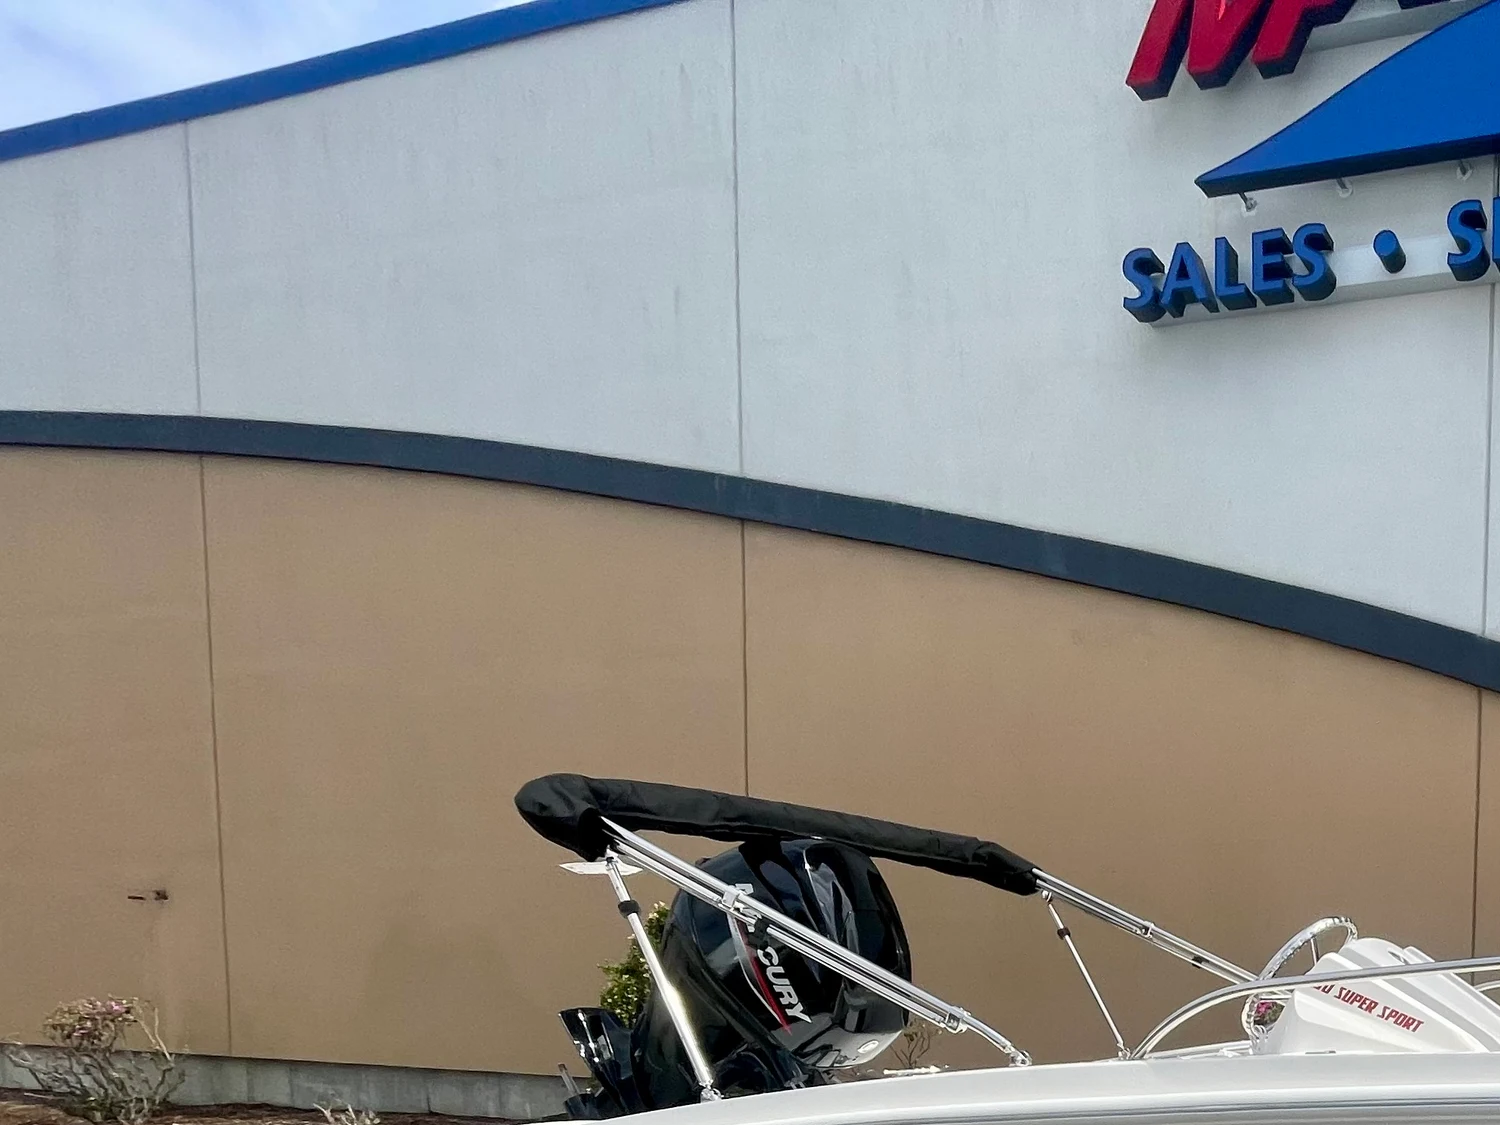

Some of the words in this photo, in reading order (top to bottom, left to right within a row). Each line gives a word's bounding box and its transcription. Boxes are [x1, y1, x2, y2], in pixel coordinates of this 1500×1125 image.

[1122, 222, 1337, 323] SALES
[735, 883, 813, 1023] CURY
[1333, 986, 1379, 1014] SUPER
[1376, 1005, 1424, 1033] SPORT
